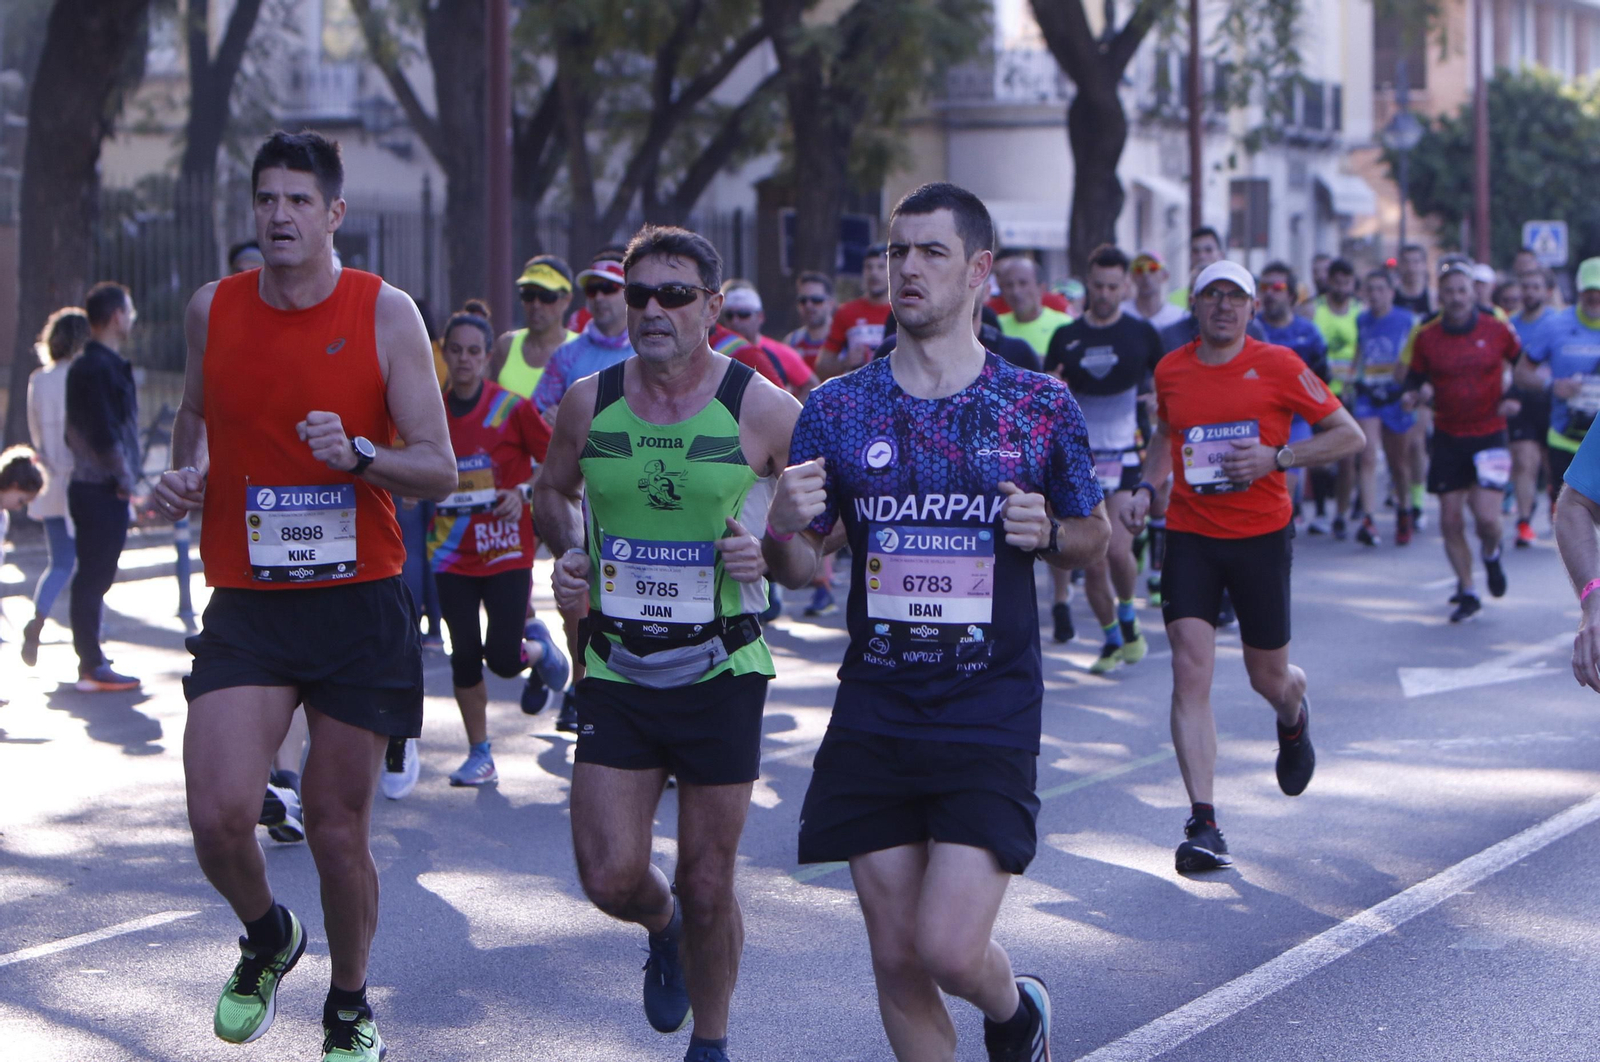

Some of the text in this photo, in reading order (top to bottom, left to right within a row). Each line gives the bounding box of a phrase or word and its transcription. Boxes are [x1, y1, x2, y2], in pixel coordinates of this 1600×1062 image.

[1206, 425, 1250, 438] ZURICH
[280, 491, 342, 506] ZURICH
[281, 525, 324, 542] 8898
[474, 520, 519, 540] RUN
[476, 533, 520, 554] NING
[903, 535, 976, 551] ZURICH
[288, 549, 316, 562] KIKE
[635, 546, 700, 561] ZURICH
[332, 572, 354, 580] ZURICH
[635, 580, 679, 598] 9785
[903, 575, 953, 593] 6783
[640, 604, 673, 618] JUAN
[908, 603, 943, 618] IBAN
